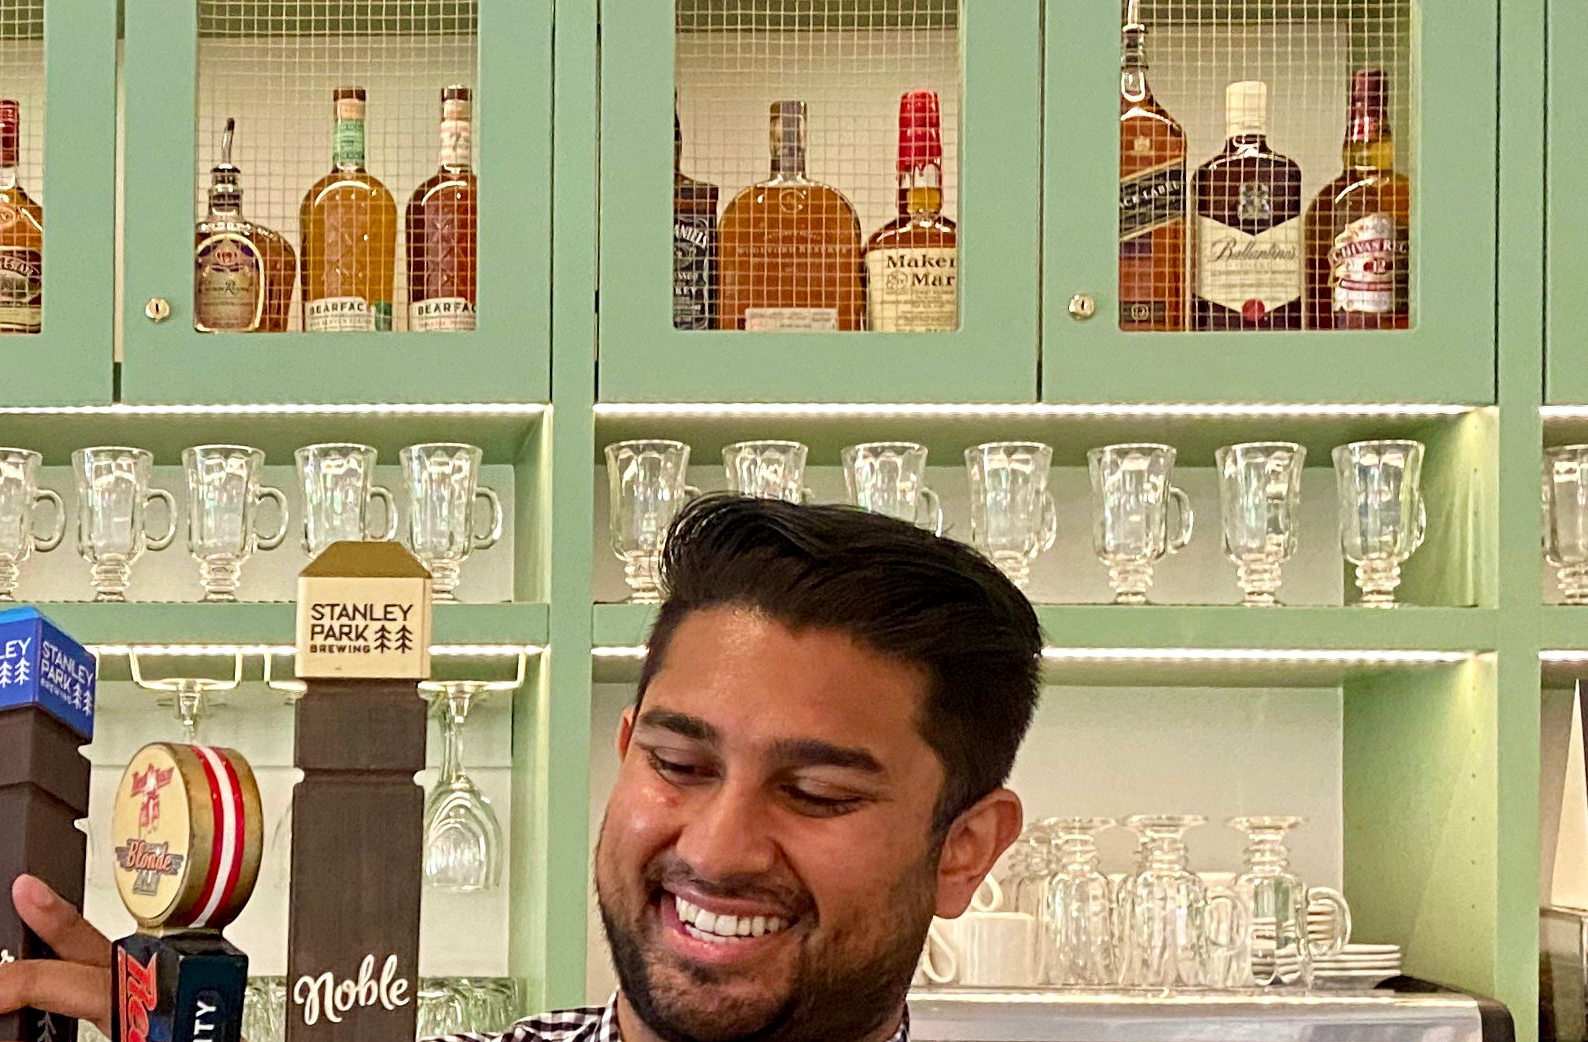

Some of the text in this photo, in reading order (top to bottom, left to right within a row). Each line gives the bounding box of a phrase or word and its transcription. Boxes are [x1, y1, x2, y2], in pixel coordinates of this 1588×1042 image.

[311, 603, 414, 622] STANLEY
[309, 644, 371, 654] BREWING
[310, 623, 369, 642] PARK
[40, 658, 72, 692] PARK
[41, 640, 94, 687] STANLEY
[126, 838, 173, 872] Blonde
[293, 953, 411, 1026] Noble
